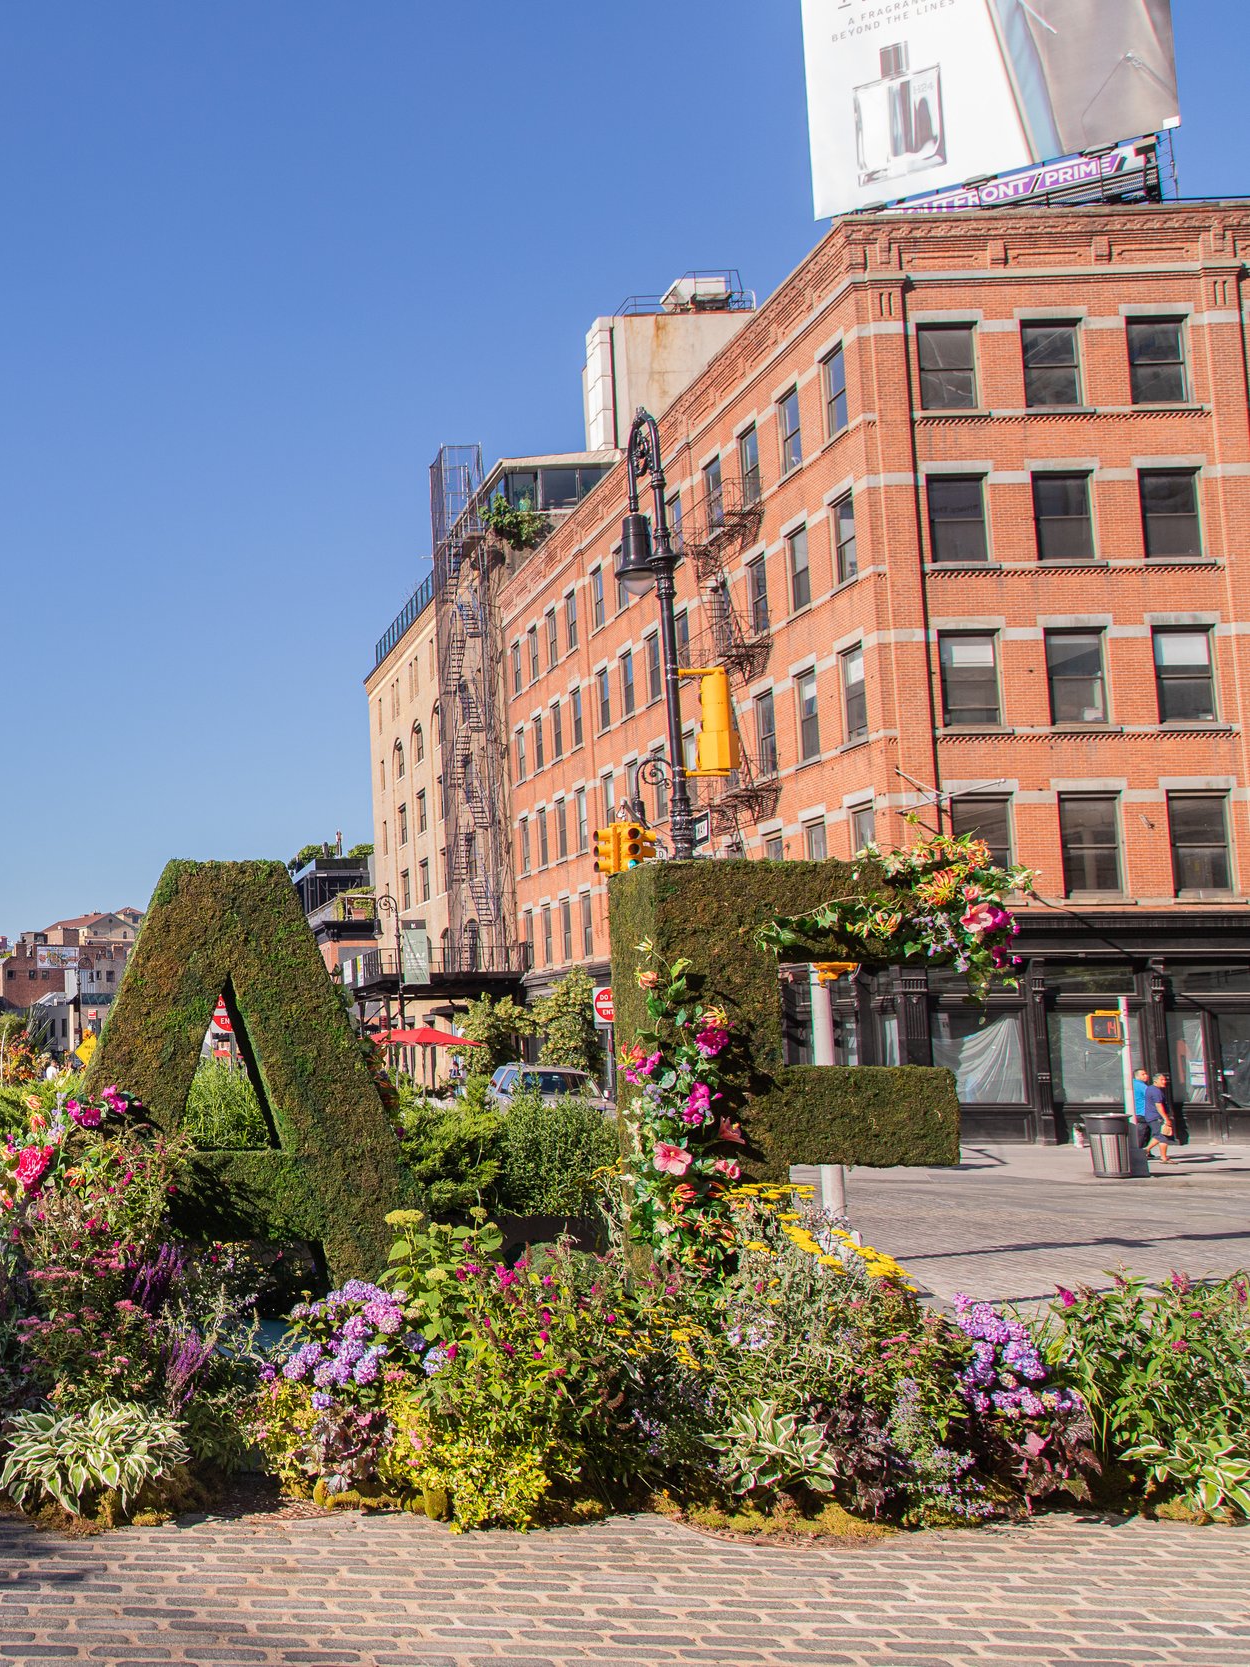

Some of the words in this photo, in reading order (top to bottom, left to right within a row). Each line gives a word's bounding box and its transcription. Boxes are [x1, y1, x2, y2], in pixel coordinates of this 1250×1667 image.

[831, 21, 881, 43] BEYOND
[886, 11, 910, 25] THE
[916, 0, 955, 16] LINES
[848, 17, 855, 26] A
[861, 0, 927, 21] FRAGRAN
[912, 80, 935, 95] H24
[1044, 155, 1114, 187] PRIME
[1107, 1021, 1117, 1035] 14
